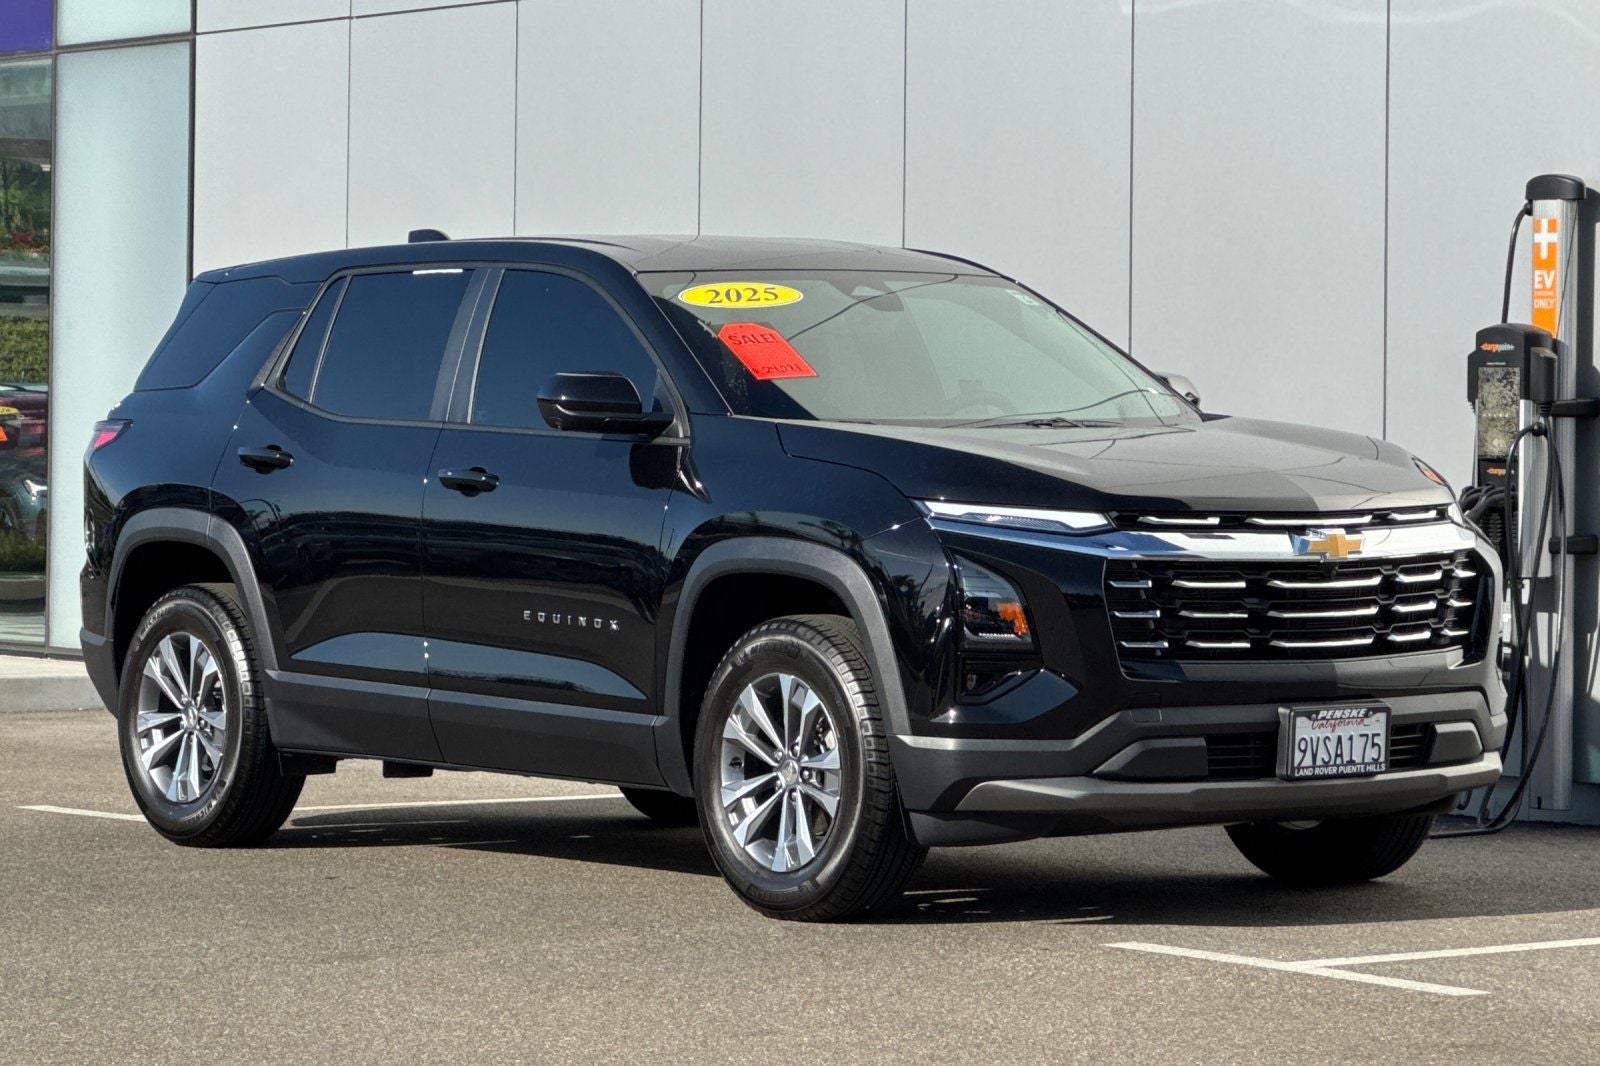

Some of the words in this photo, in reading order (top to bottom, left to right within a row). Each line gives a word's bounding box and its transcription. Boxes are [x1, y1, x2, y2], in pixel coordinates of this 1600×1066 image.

[1534, 269, 1555, 289] EV
[705, 287, 779, 304] 2025
[727, 333, 779, 345] SALE!
[523, 610, 620, 631] EQUINOX
[1317, 708, 1367, 719] PENSKE
[1297, 733, 1381, 767] 9VSA175
[1295, 766, 1313, 776] LAND
[1314, 765, 1337, 775] ROVER
[1338, 763, 1365, 774] PUENTE
[1366, 763, 1386, 772] HILLS
